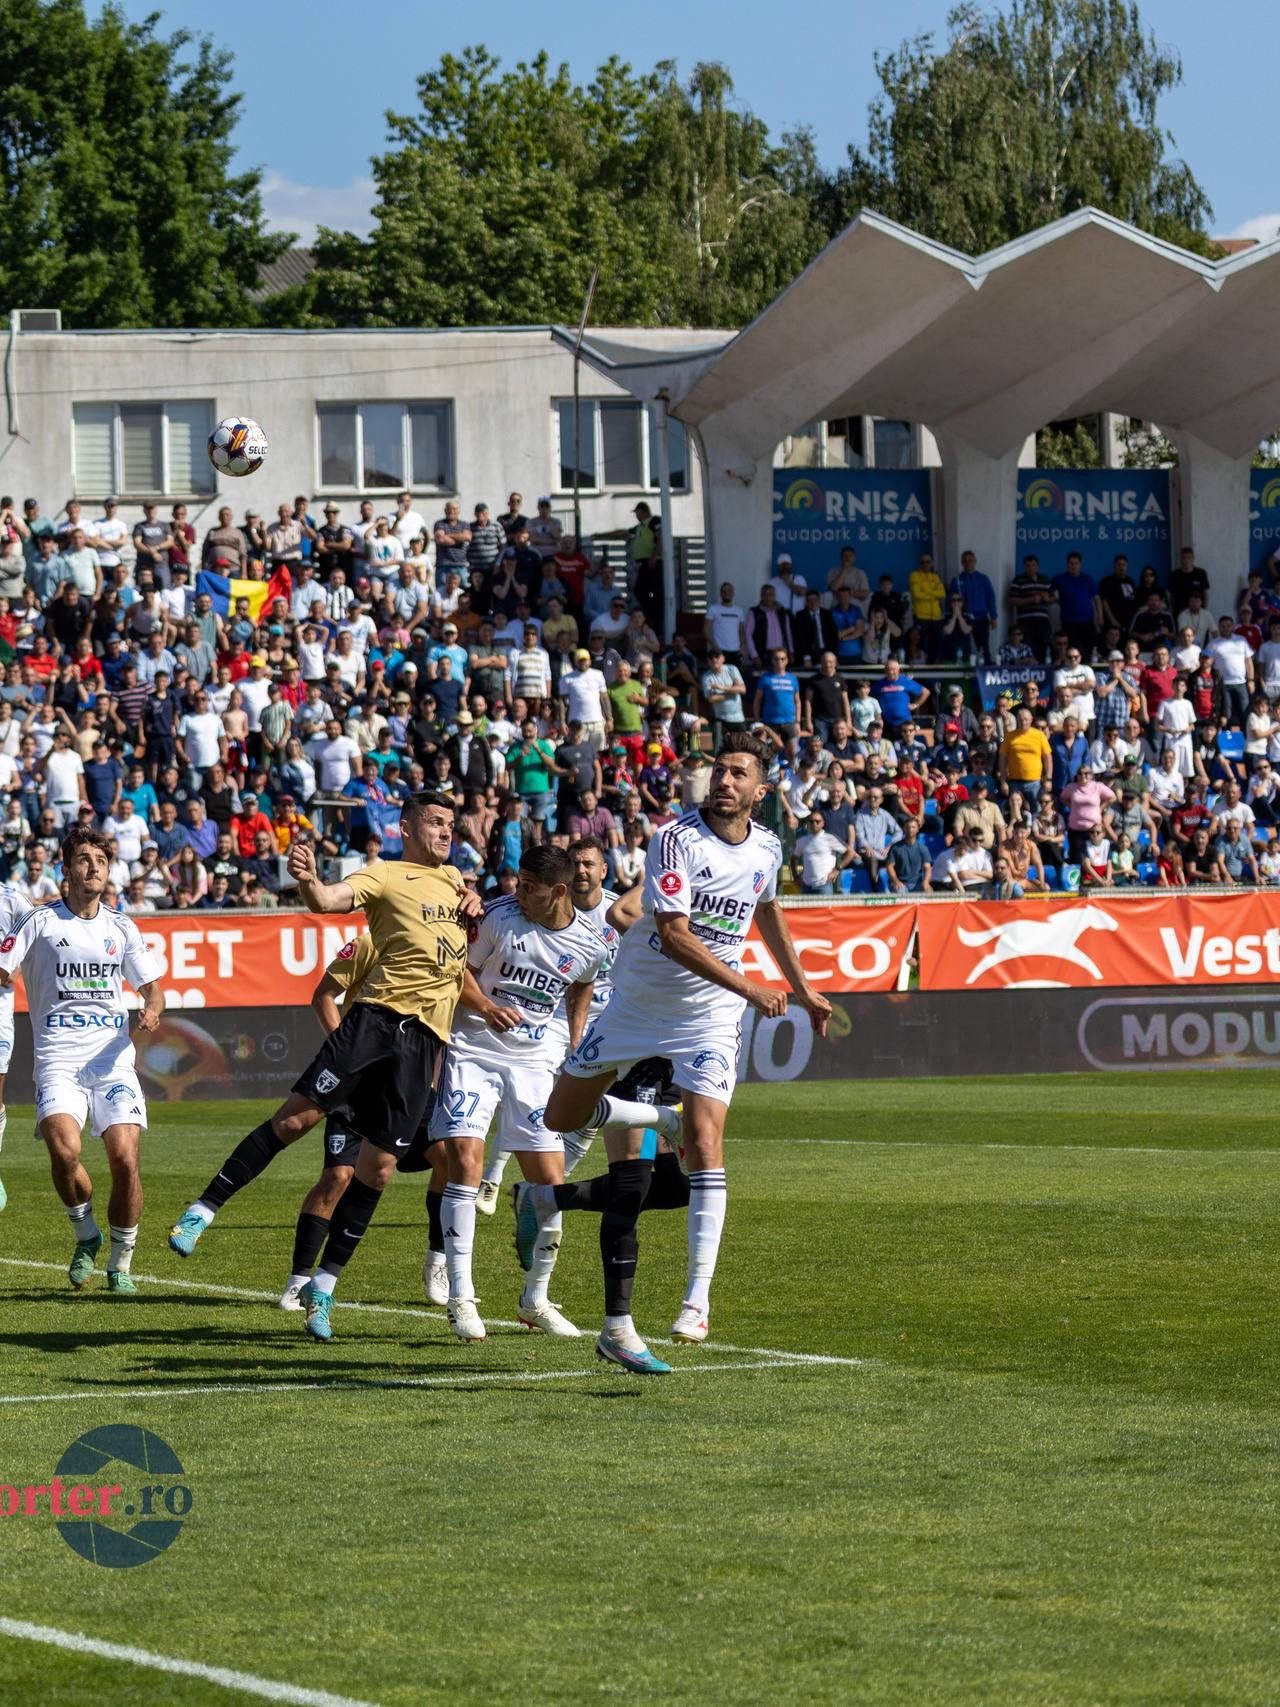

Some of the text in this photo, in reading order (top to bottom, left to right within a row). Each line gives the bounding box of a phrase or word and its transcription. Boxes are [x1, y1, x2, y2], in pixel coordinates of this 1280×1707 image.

[775, 526, 851, 544] quapark
[877, 527, 929, 544] sports
[1017, 526, 1090, 542] quapark
[1116, 527, 1168, 542] sports
[985, 667, 1046, 686] Mândru
[141, 930, 243, 979] BET
[740, 936, 891, 981] ACO
[56, 963, 120, 978] UNIBET
[499, 961, 569, 995] UNIBET
[46, 1014, 124, 1029] ELSACO
[577, 1026, 605, 1062] 16
[450, 1089, 480, 1118] 27
